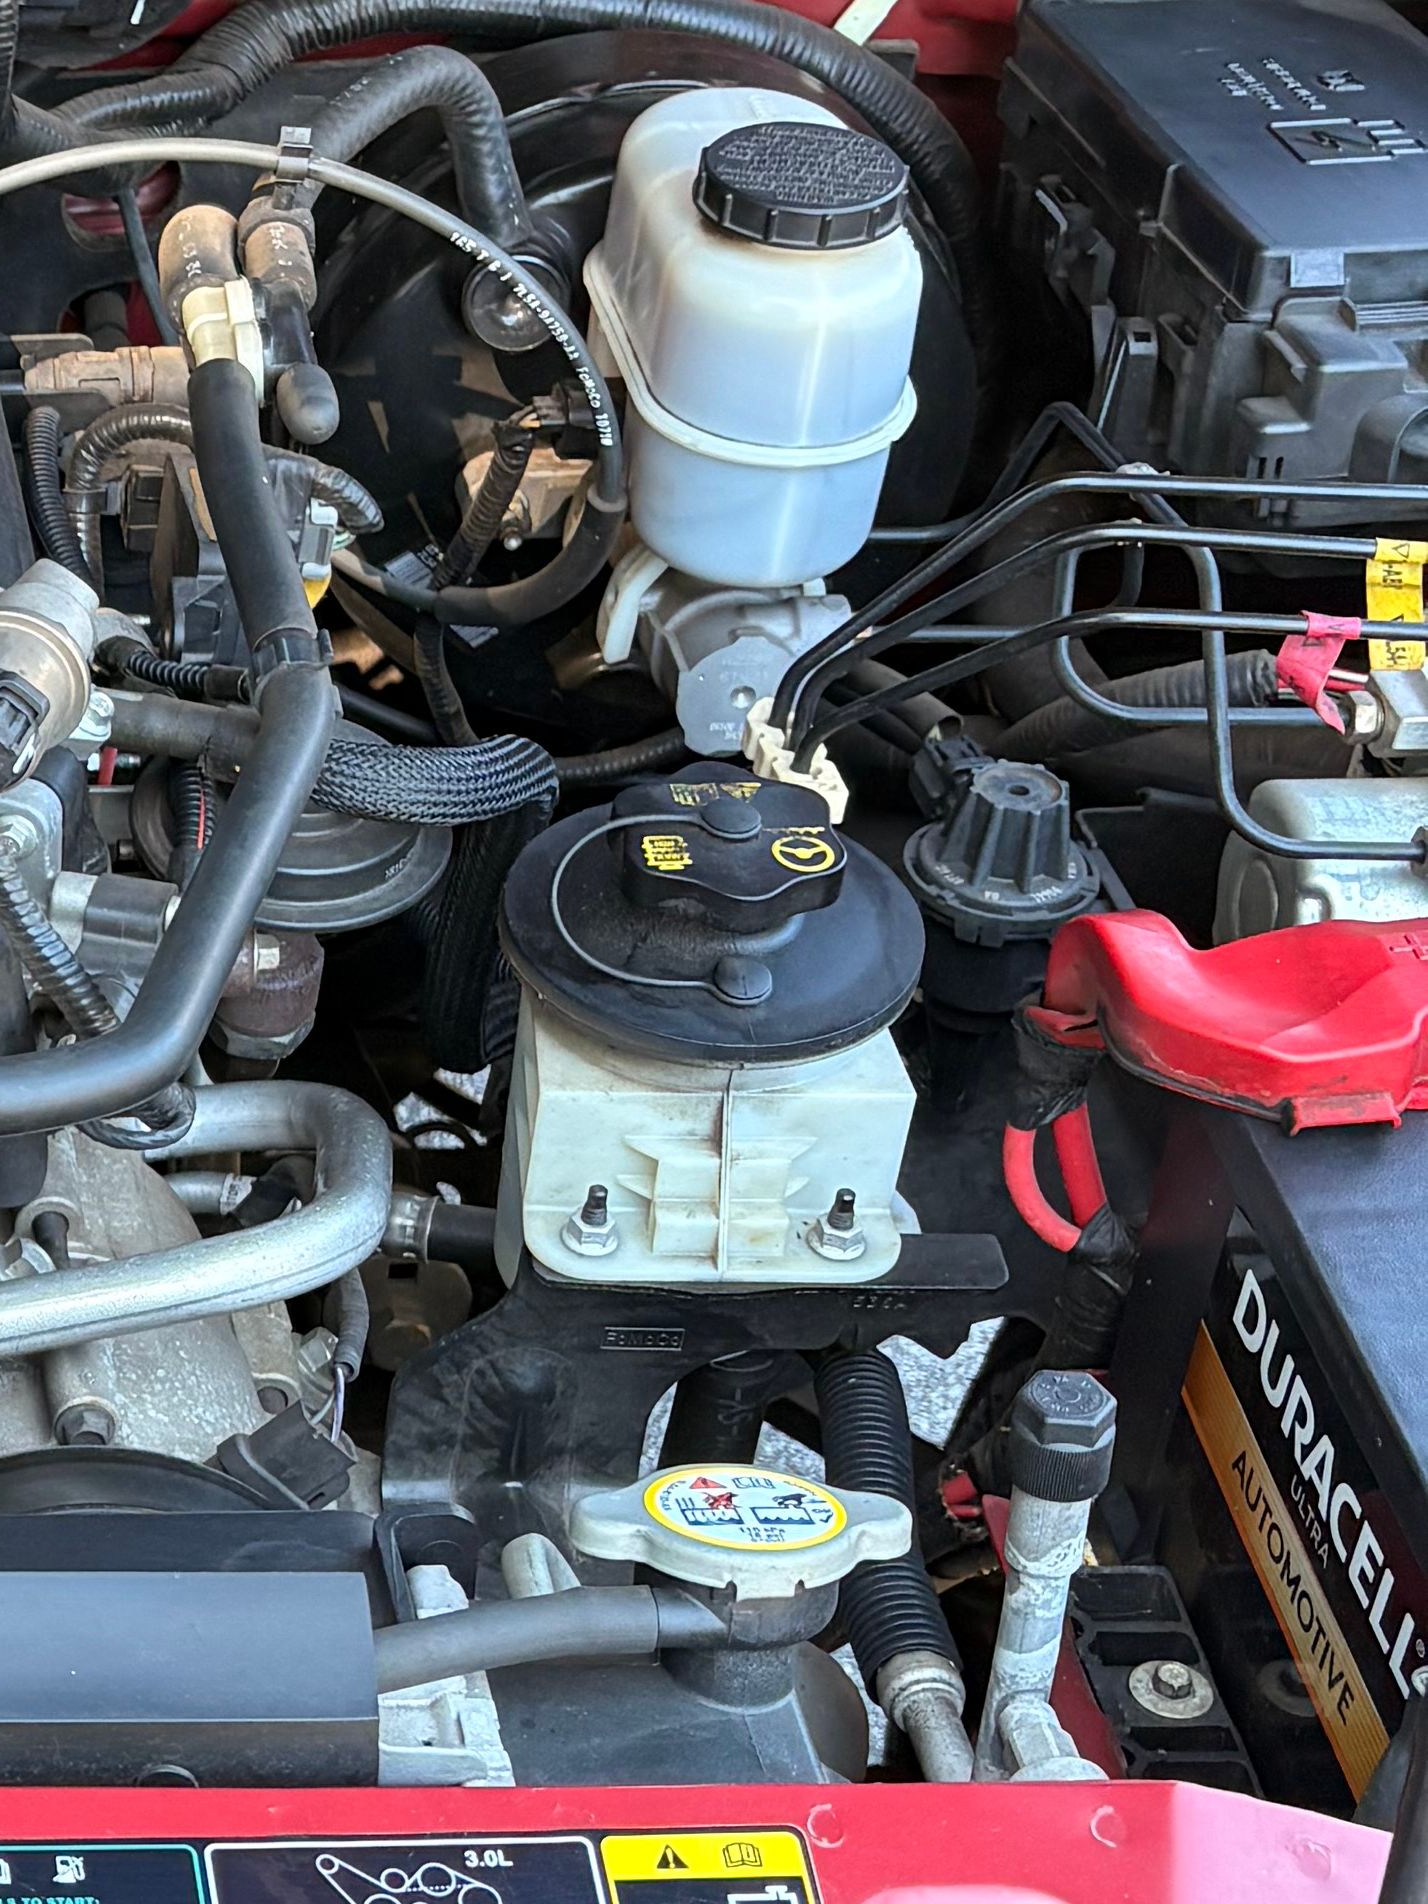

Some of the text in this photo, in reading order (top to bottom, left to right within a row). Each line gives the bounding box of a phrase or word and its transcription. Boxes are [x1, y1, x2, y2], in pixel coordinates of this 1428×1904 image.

[1232, 1268, 1414, 1700] DURACELL
[1290, 1474, 1329, 1568] ULTRA
[1232, 1450, 1355, 1725] AUTOMOTIVE
[464, 1850, 513, 1867] 3.0L
